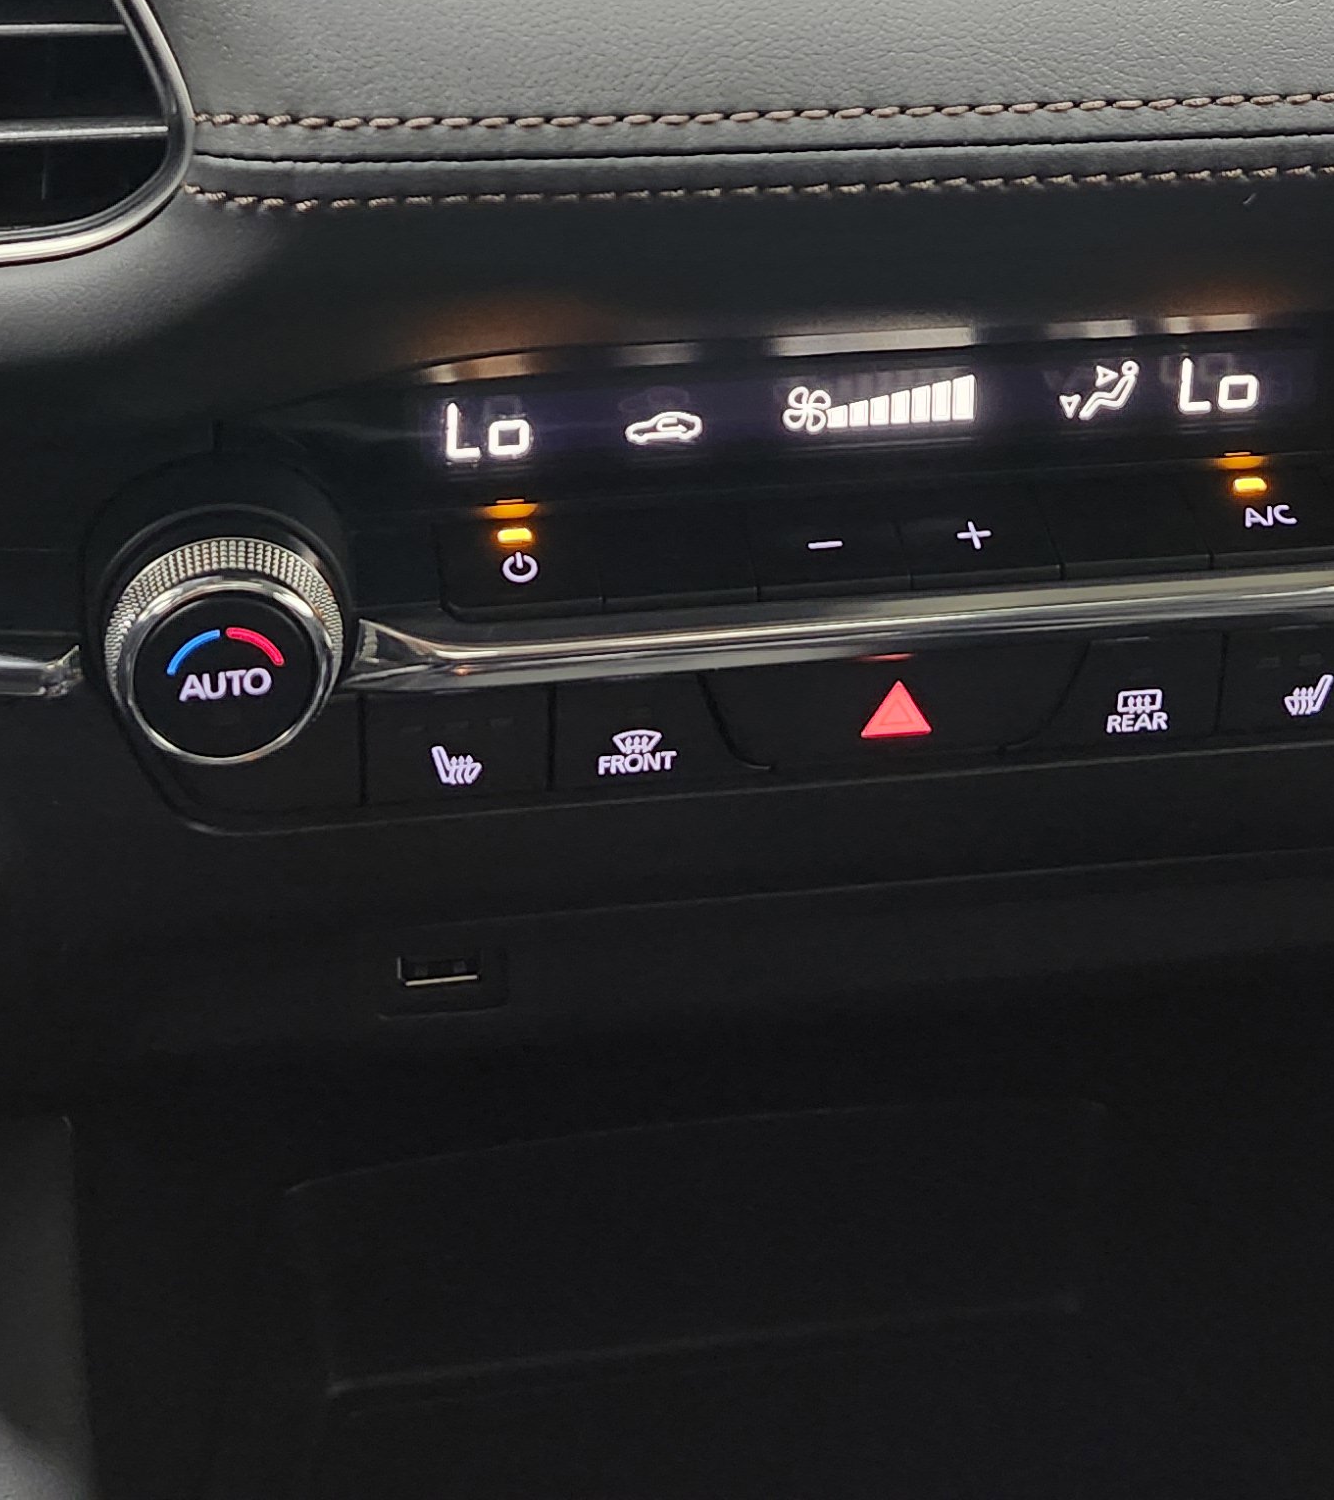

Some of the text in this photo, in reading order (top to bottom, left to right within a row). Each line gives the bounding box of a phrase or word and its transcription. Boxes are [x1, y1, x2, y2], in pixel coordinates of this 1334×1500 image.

[1177, 357, 1260, 415] Lo
[441, 402, 535, 464] Lo
[1244, 503, 1298, 528] A/C
[178, 667, 273, 702] AUTO
[1105, 709, 1169, 734] REAR
[597, 749, 678, 776] FRONT
